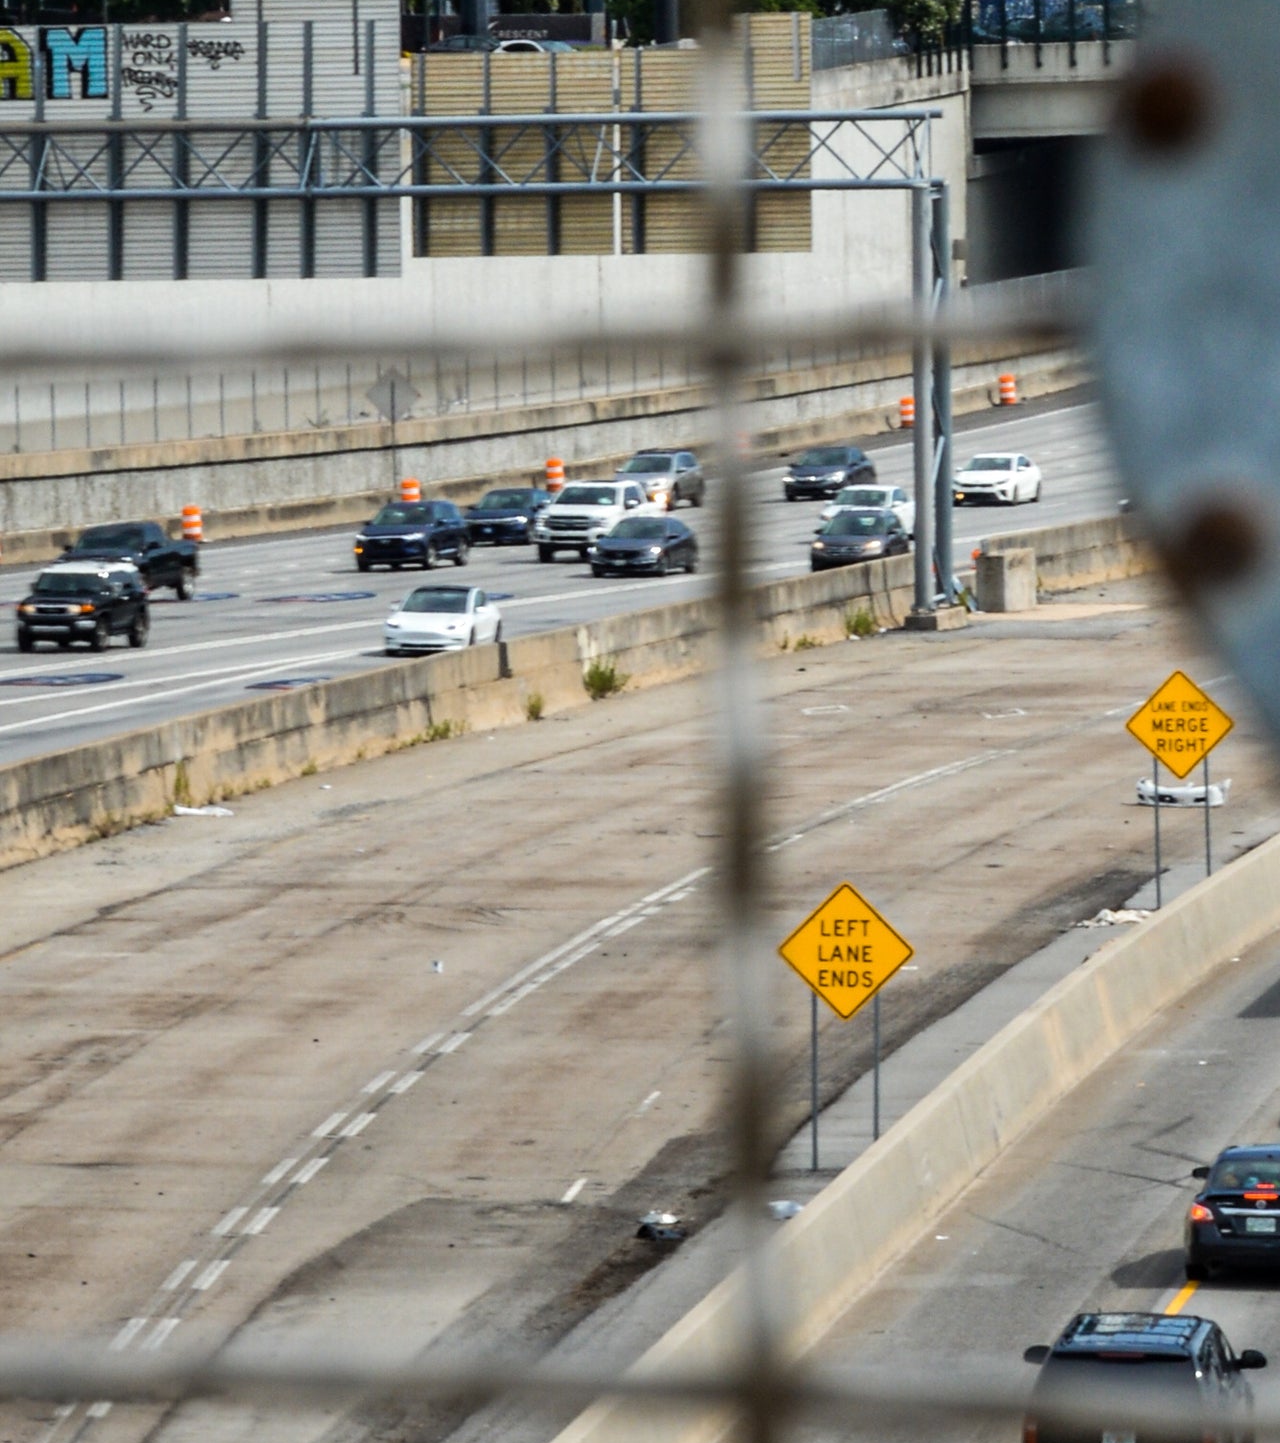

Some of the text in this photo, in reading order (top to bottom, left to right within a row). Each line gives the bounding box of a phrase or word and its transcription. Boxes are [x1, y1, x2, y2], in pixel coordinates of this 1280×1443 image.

[1151, 700, 1208, 713] LANE ENDS
[1151, 717, 1209, 733] MERGE
[1156, 737, 1206, 753] RIGHT
[820, 919, 871, 938] LEFT
[818, 944, 873, 963] LANE
[818, 969, 874, 988] ENDS
